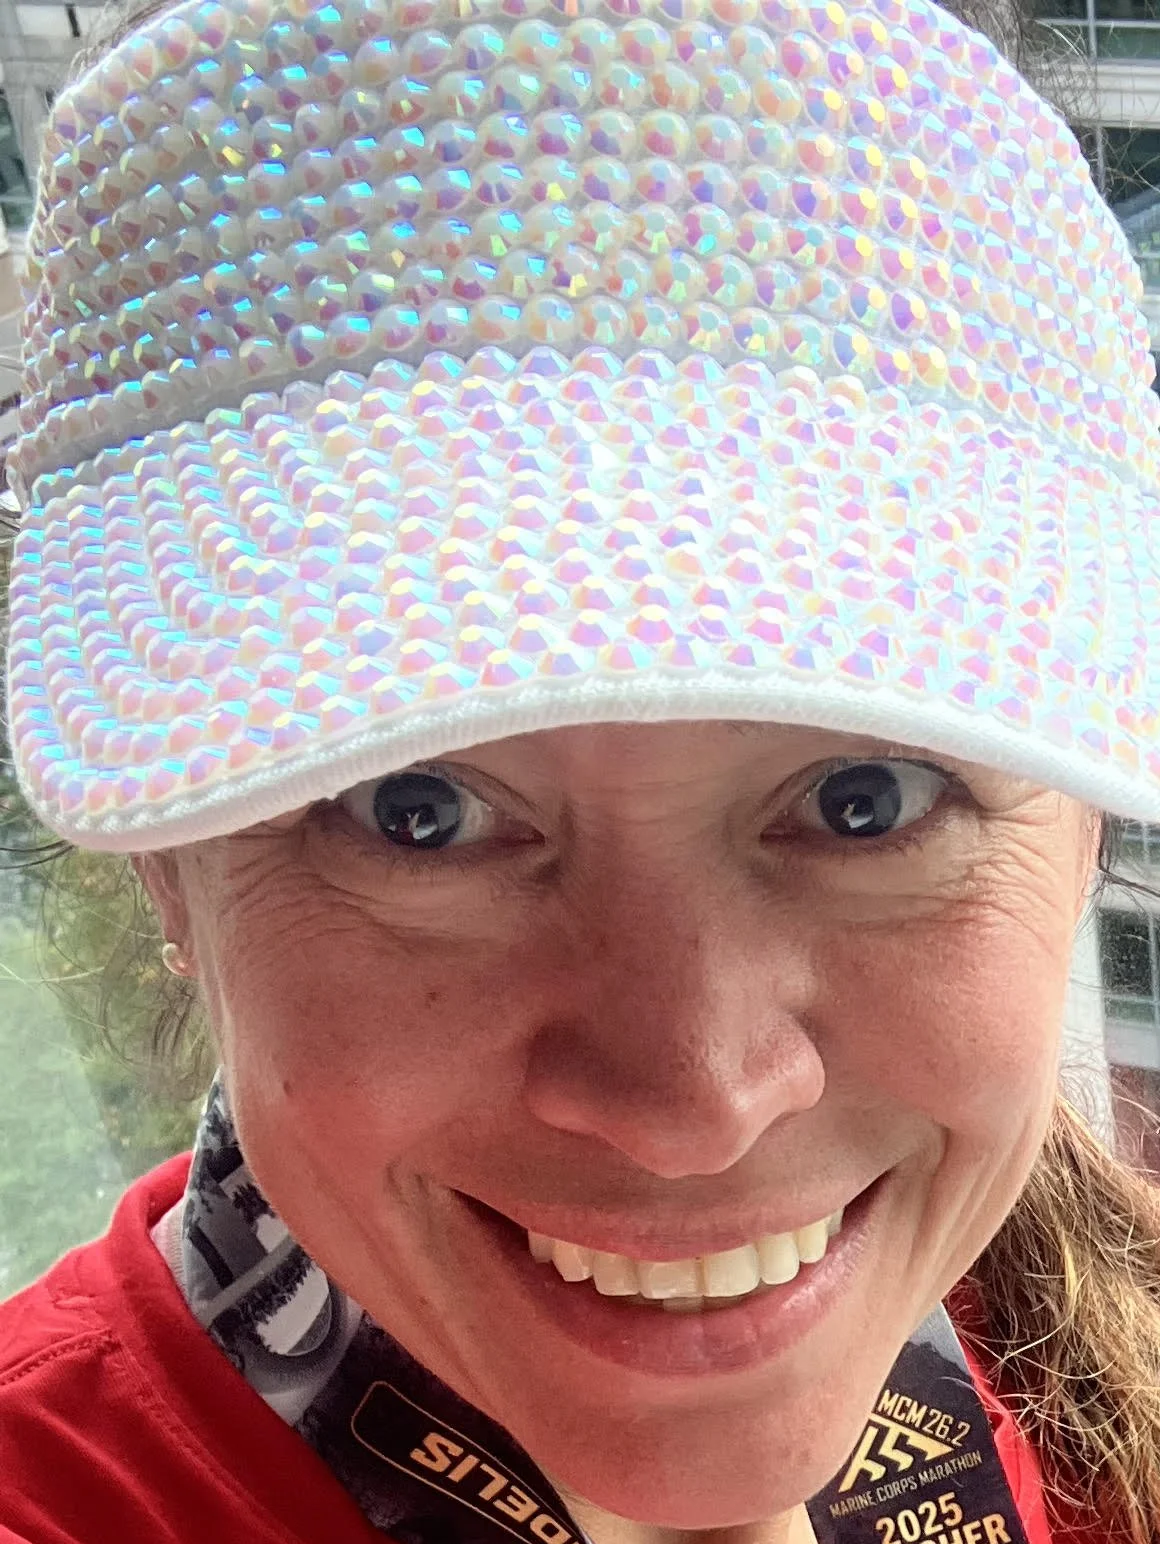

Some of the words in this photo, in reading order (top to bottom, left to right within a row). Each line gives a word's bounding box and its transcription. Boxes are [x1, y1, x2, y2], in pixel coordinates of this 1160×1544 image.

[829, 1490, 877, 1519] MARINE
[876, 1475, 918, 1503] CORPS
[918, 1450, 983, 1486] MARATHON
